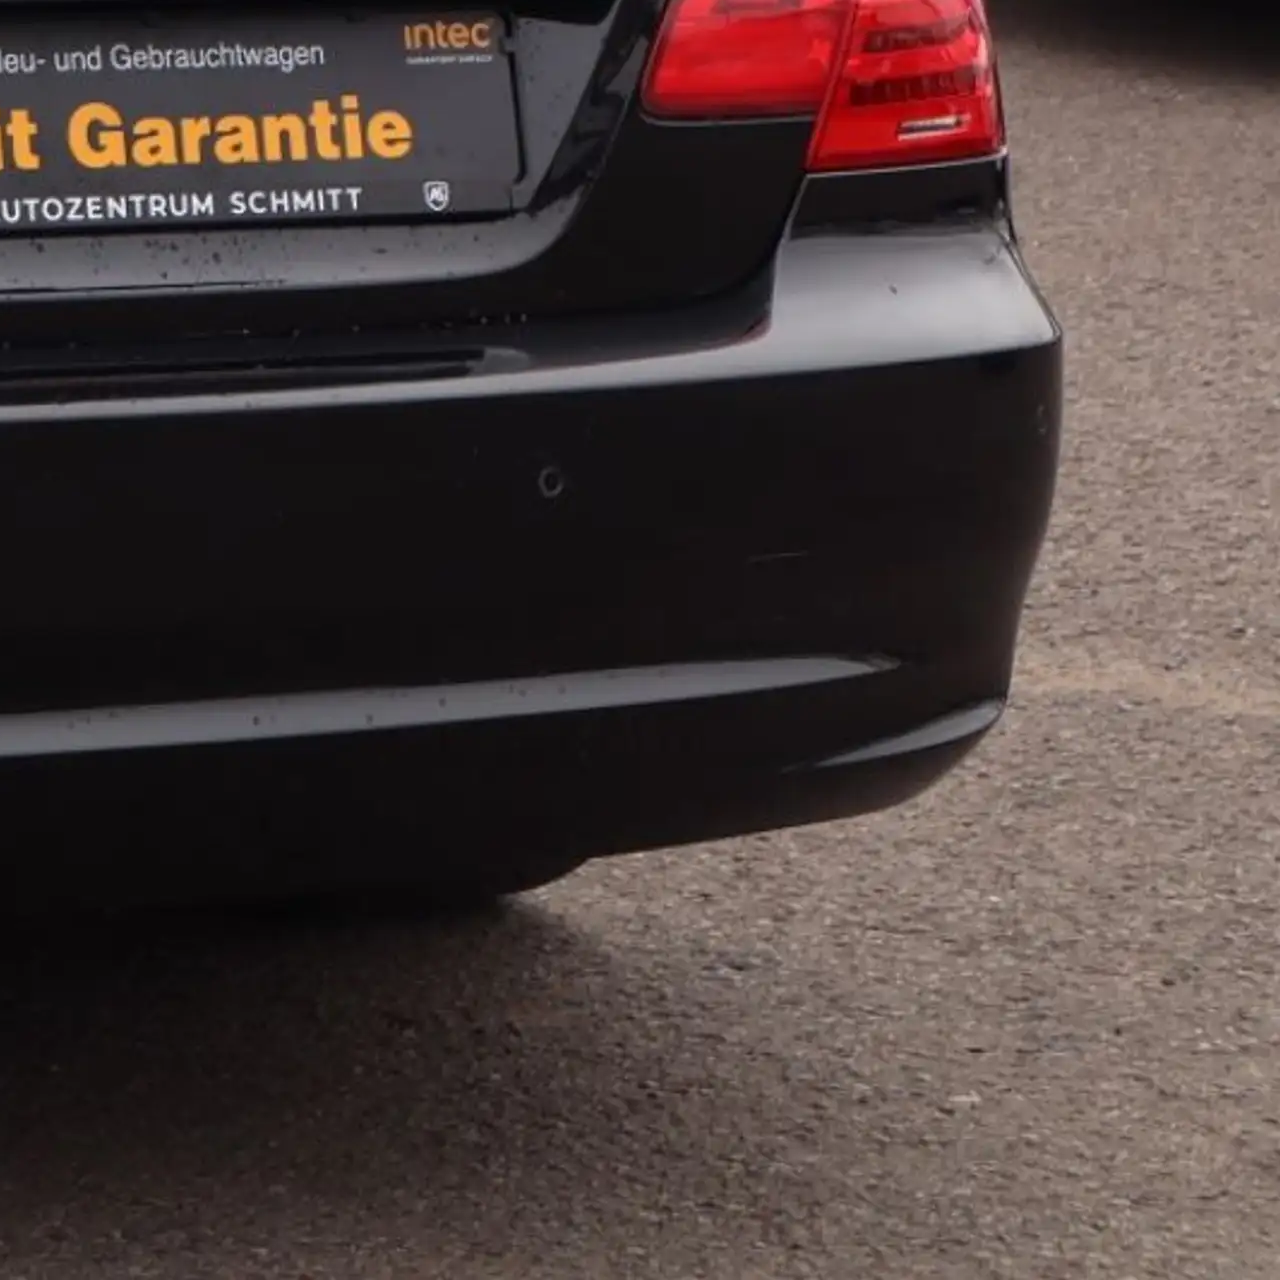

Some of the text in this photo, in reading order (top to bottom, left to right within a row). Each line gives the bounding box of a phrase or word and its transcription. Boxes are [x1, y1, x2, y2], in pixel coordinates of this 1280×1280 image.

[53, 44, 103, 73] und
[110, 40, 325, 76] Gebrauchtwagen
[67, 94, 415, 170] Garantie
[229, 186, 363, 215] SCHMITT
